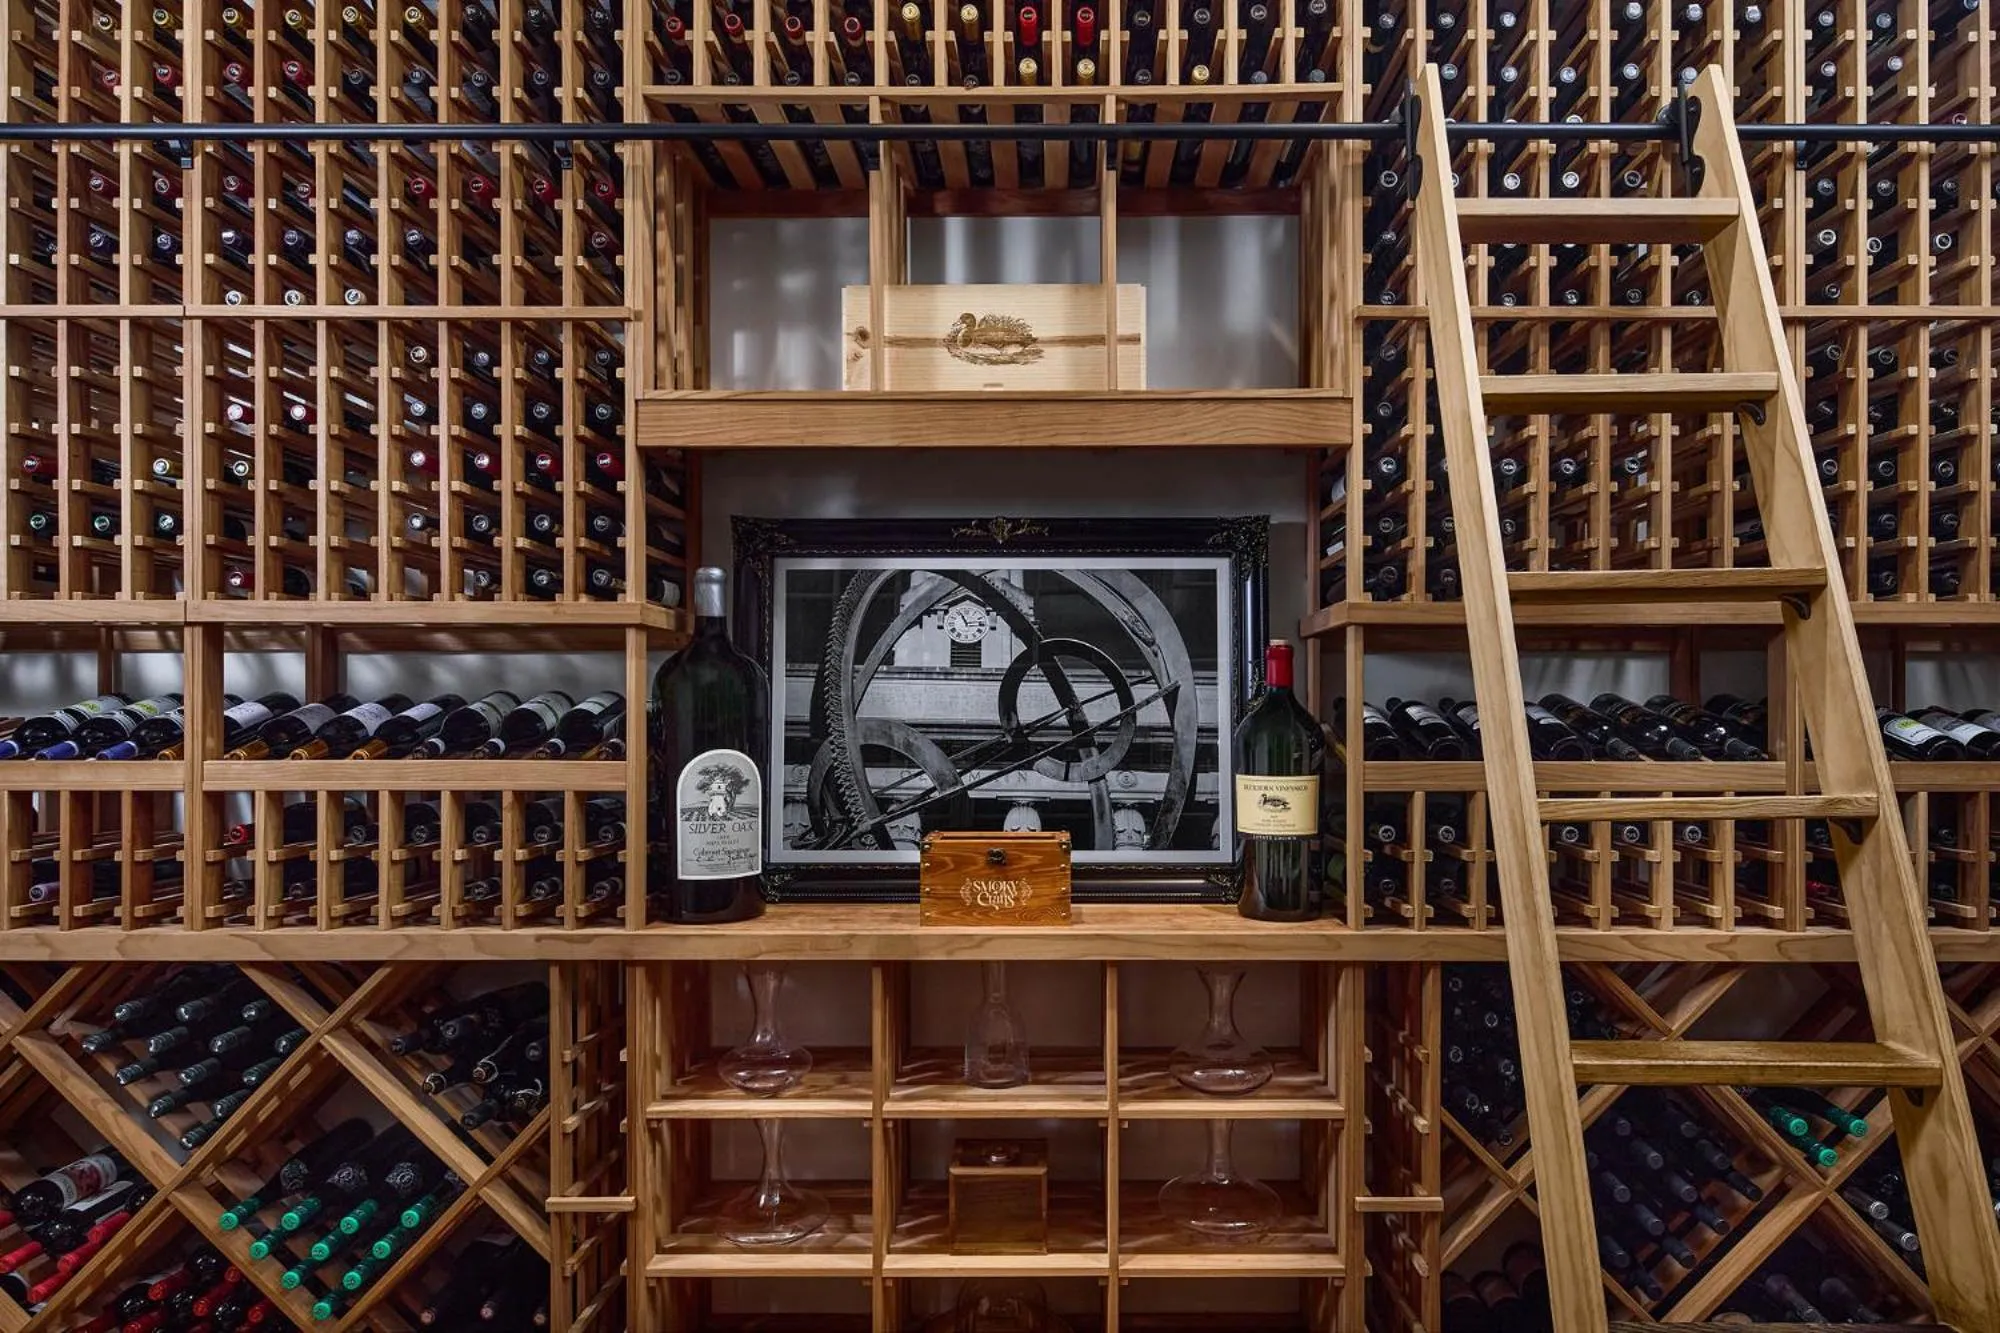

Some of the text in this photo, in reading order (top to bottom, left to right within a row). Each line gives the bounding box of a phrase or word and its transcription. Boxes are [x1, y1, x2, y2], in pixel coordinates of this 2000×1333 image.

[689, 821, 756, 834] SILVER OAK
[973, 880, 1018, 896] SMOKY
